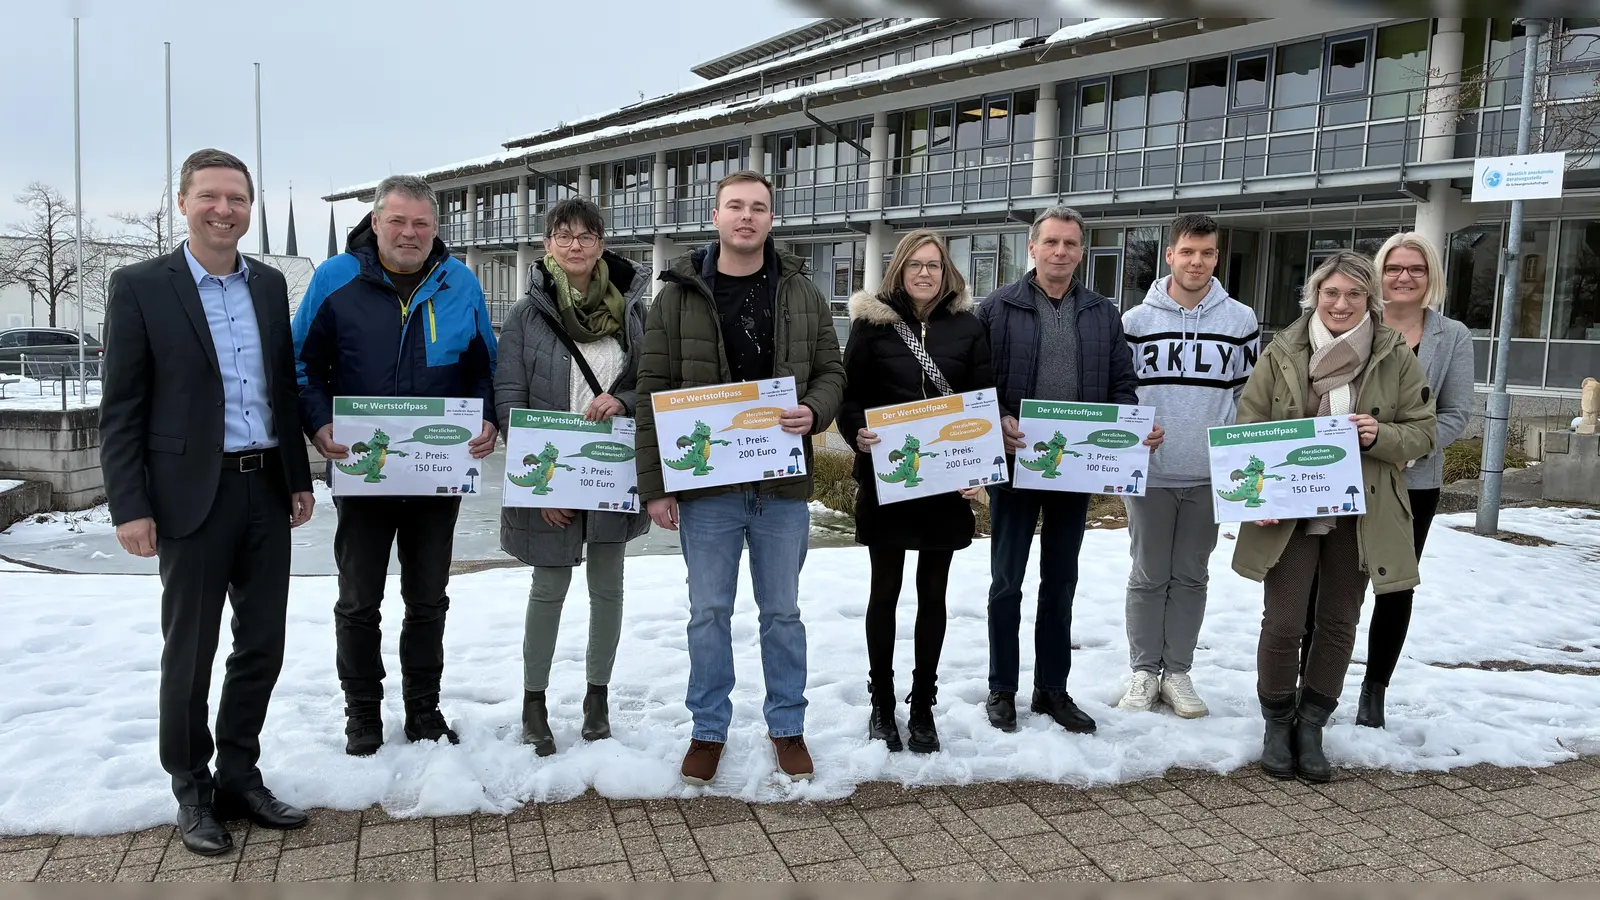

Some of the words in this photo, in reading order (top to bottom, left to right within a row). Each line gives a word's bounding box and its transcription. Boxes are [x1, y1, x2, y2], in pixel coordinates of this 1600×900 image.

[670, 396, 685, 405] Der
[686, 390, 742, 402] Wertstoffpass
[370, 402, 428, 411] Wertstoffpass
[882, 412, 896, 420] Der
[897, 403, 948, 417] Wertstoffpass
[1052, 408, 1103, 417] Wertstoffpass
[543, 416, 597, 427] Wertstoffpass
[952, 421, 978, 430] Herzlichen
[949, 427, 982, 437] Glückwunsch!
[1226, 432, 1240, 440] Der
[1242, 427, 1298, 438] Wertstoffpass
[737, 438, 744, 446] 1.
[746, 436, 769, 445] Preis:
[415, 452, 423, 460] 2.
[425, 452, 449, 460] Preis:
[739, 450, 755, 459] 200
[757, 448, 777, 457] Euro
[944, 449, 950, 457] 1.
[952, 447, 974, 456] Preis:
[1097, 453, 1118, 462] Preis:
[1297, 454, 1335, 462] Glückwunsch!
[415, 464, 430, 472] 150
[432, 464, 453, 472] Euro
[946, 461, 961, 469] 200
[963, 458, 982, 466] Euro
[581, 467, 588, 475] 3.
[591, 467, 613, 476] Preis:
[1086, 464, 1100, 472] 100
[1101, 465, 1120, 473] Euro
[1291, 474, 1299, 482] 2.
[1301, 473, 1326, 481] Preis:
[580, 479, 594, 487] 100
[596, 480, 615, 488] Euro
[1292, 486, 1307, 494] 150
[1310, 485, 1331, 493] Euro
